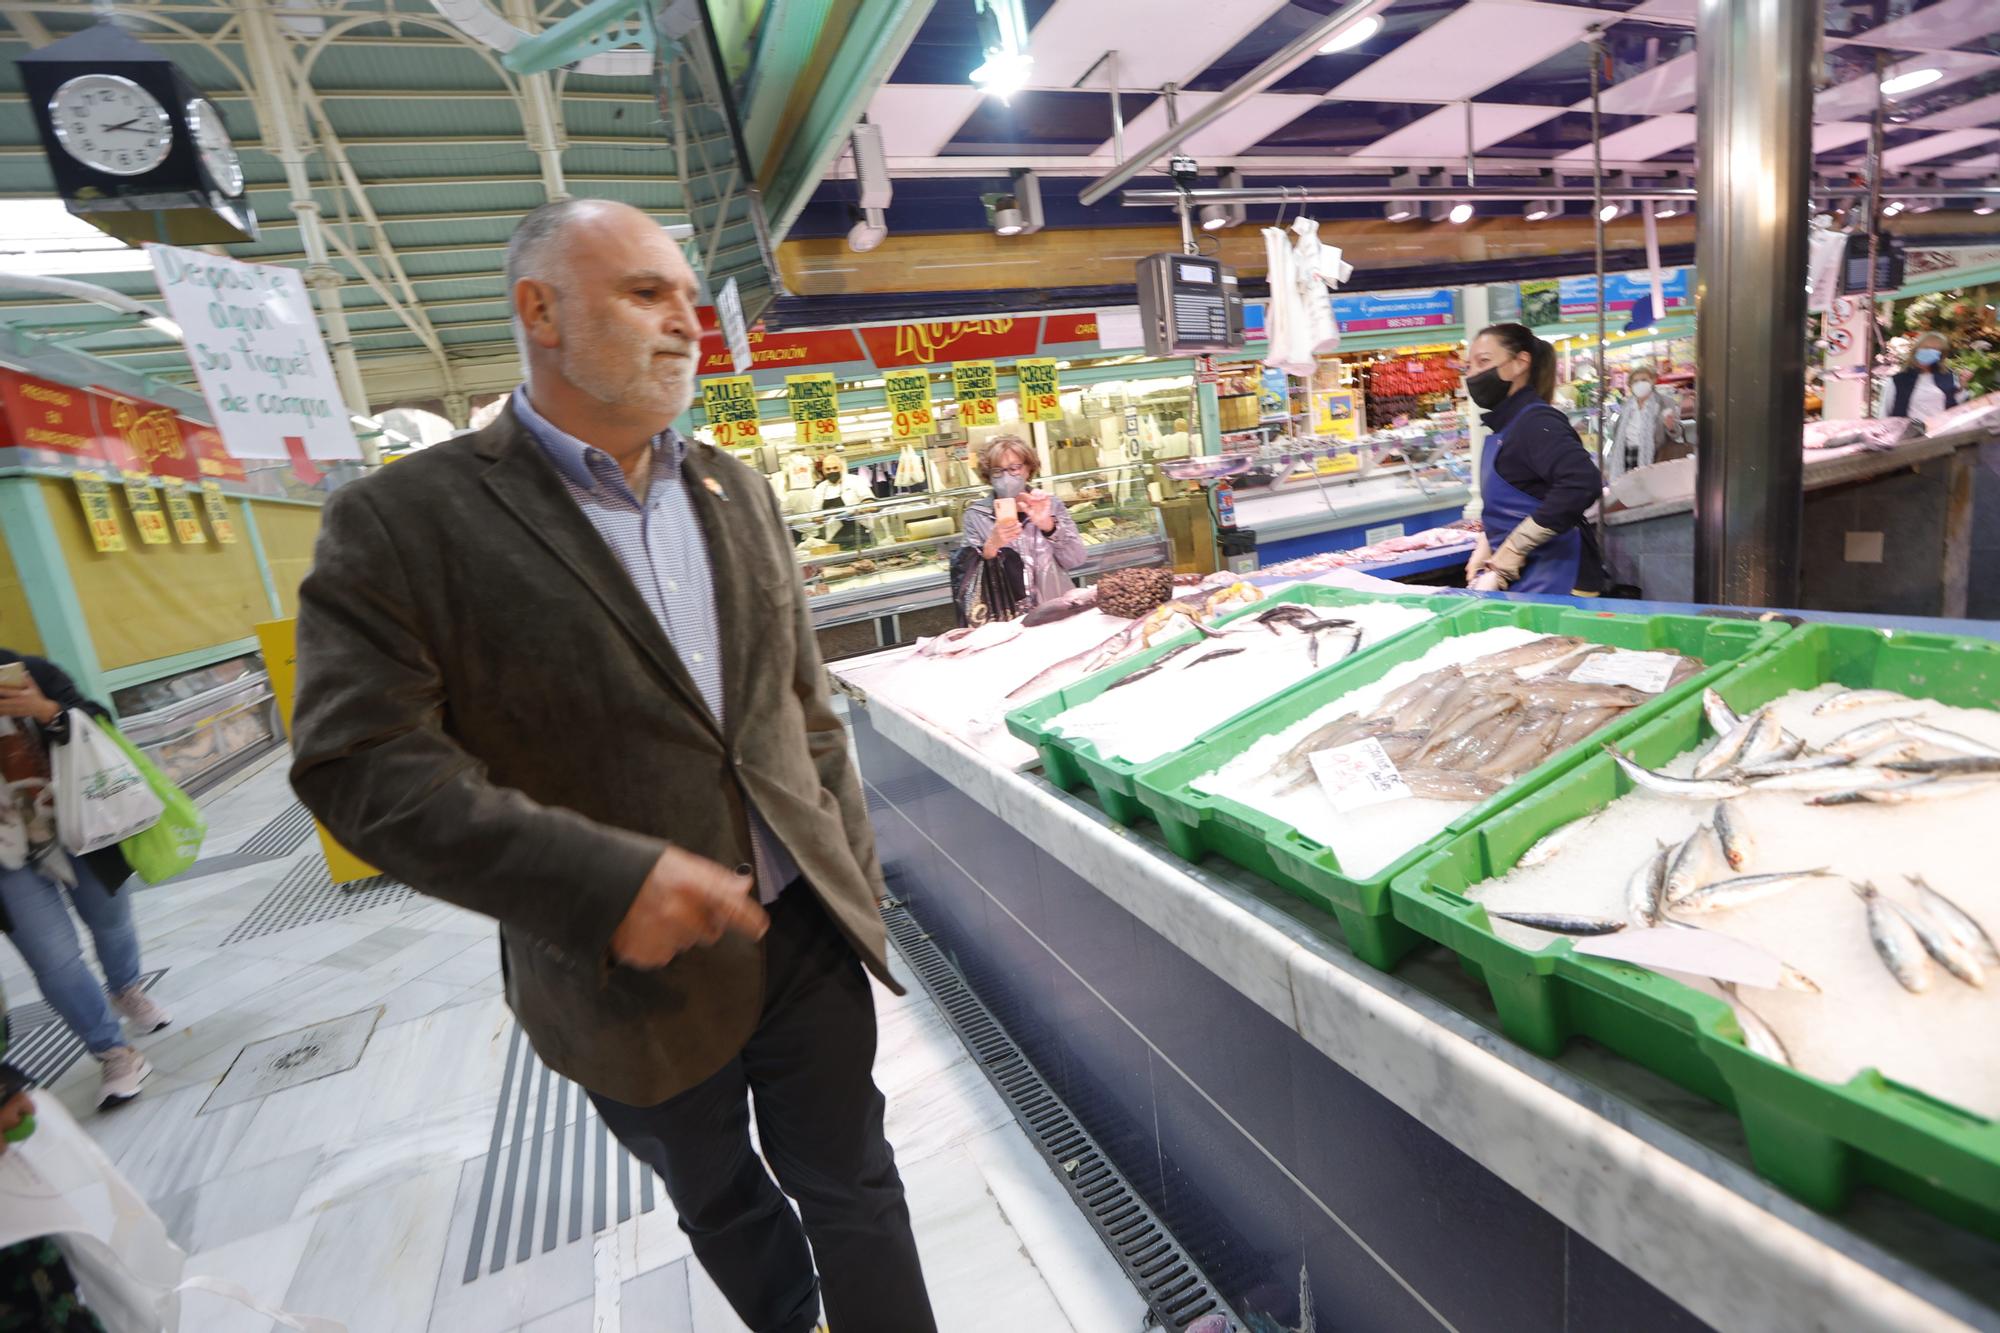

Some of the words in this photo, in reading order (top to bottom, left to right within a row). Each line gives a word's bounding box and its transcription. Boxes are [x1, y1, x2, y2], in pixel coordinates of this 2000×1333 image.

[219, 383, 249, 413] de
[1026, 399, 1040, 420] 4
[797, 421, 813, 444] 7
[895, 412, 911, 437] 9
